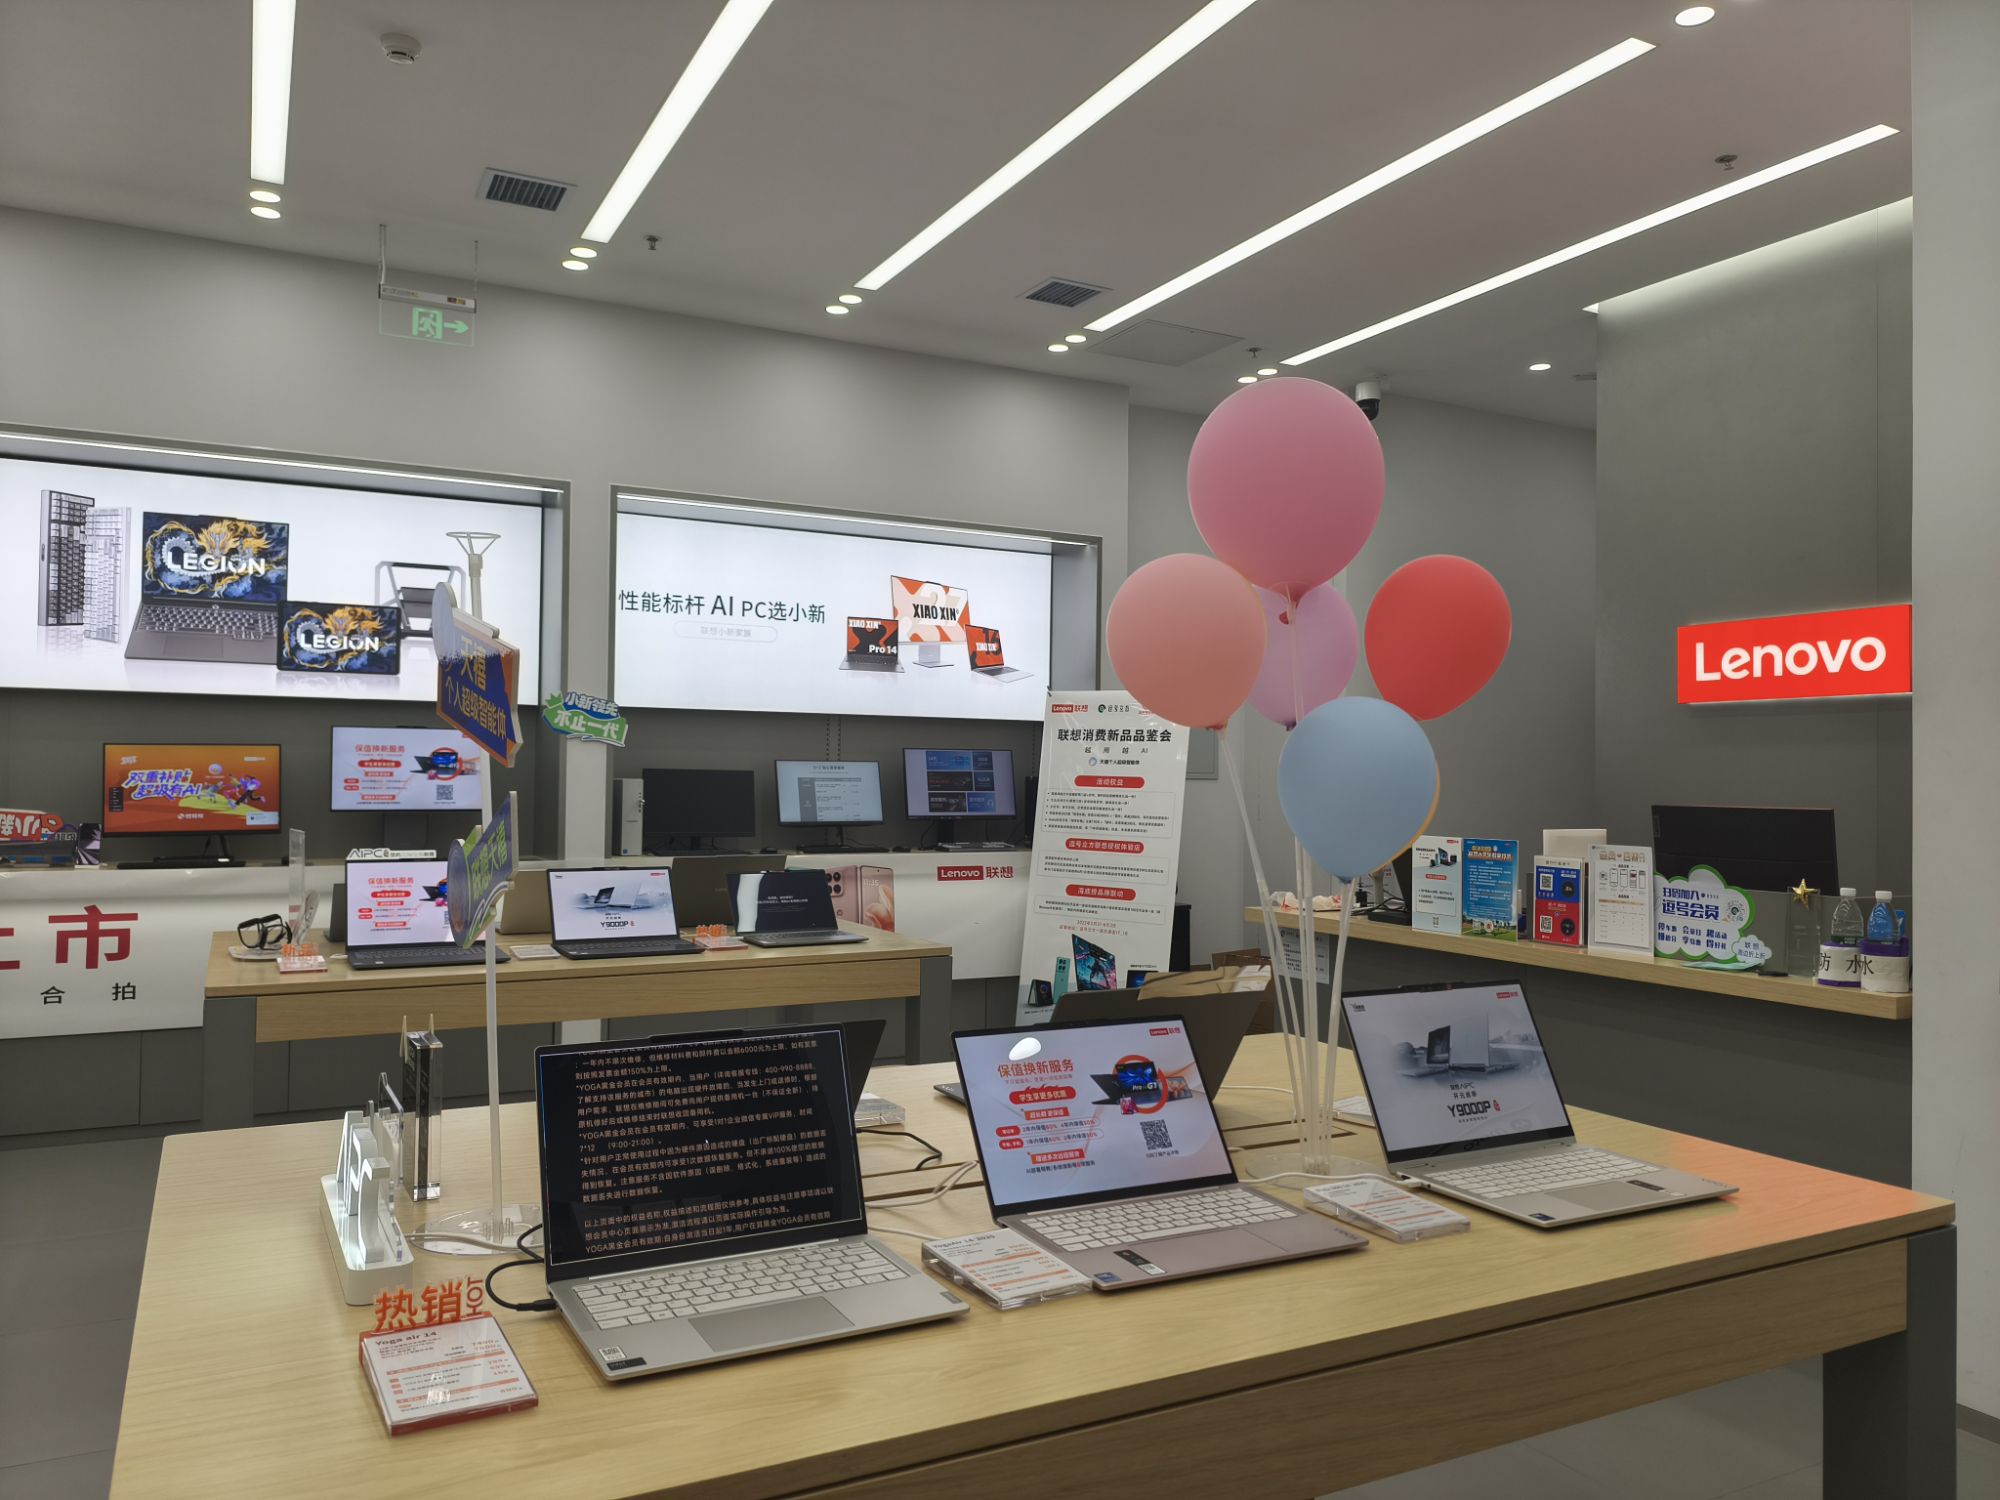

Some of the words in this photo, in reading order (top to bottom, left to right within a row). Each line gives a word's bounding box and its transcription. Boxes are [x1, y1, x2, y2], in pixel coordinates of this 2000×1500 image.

[168, 551, 266, 575] LEGION
[618, 590, 704, 616] 性能标杆
[711, 595, 734, 616] AI
[742, 601, 825, 624] PC选小新
[913, 603, 938, 619] XIAO
[939, 607, 957, 621] XIN
[848, 619, 866, 629] XIAO
[300, 633, 379, 651] LEGION
[869, 644, 885, 654] Pro
[886, 645, 897, 654] 14
[1695, 636, 1887, 682] Lenovo
[566, 691, 619, 716] 小新领先
[555, 710, 620, 739] 不止一代
[1057, 728, 1172, 742] 联想消费新品品鉴会
[121, 769, 192, 788] 双重补贴
[940, 868, 981, 879] Lenovo
[985, 866, 1014, 879] 联想
[997, 1059, 1073, 1078] 保值换新服务
[1447, 1100, 1491, 1117] Y9000P
[375, 1281, 463, 1331] 热销
[467, 1277, 483, 1316] HOT
